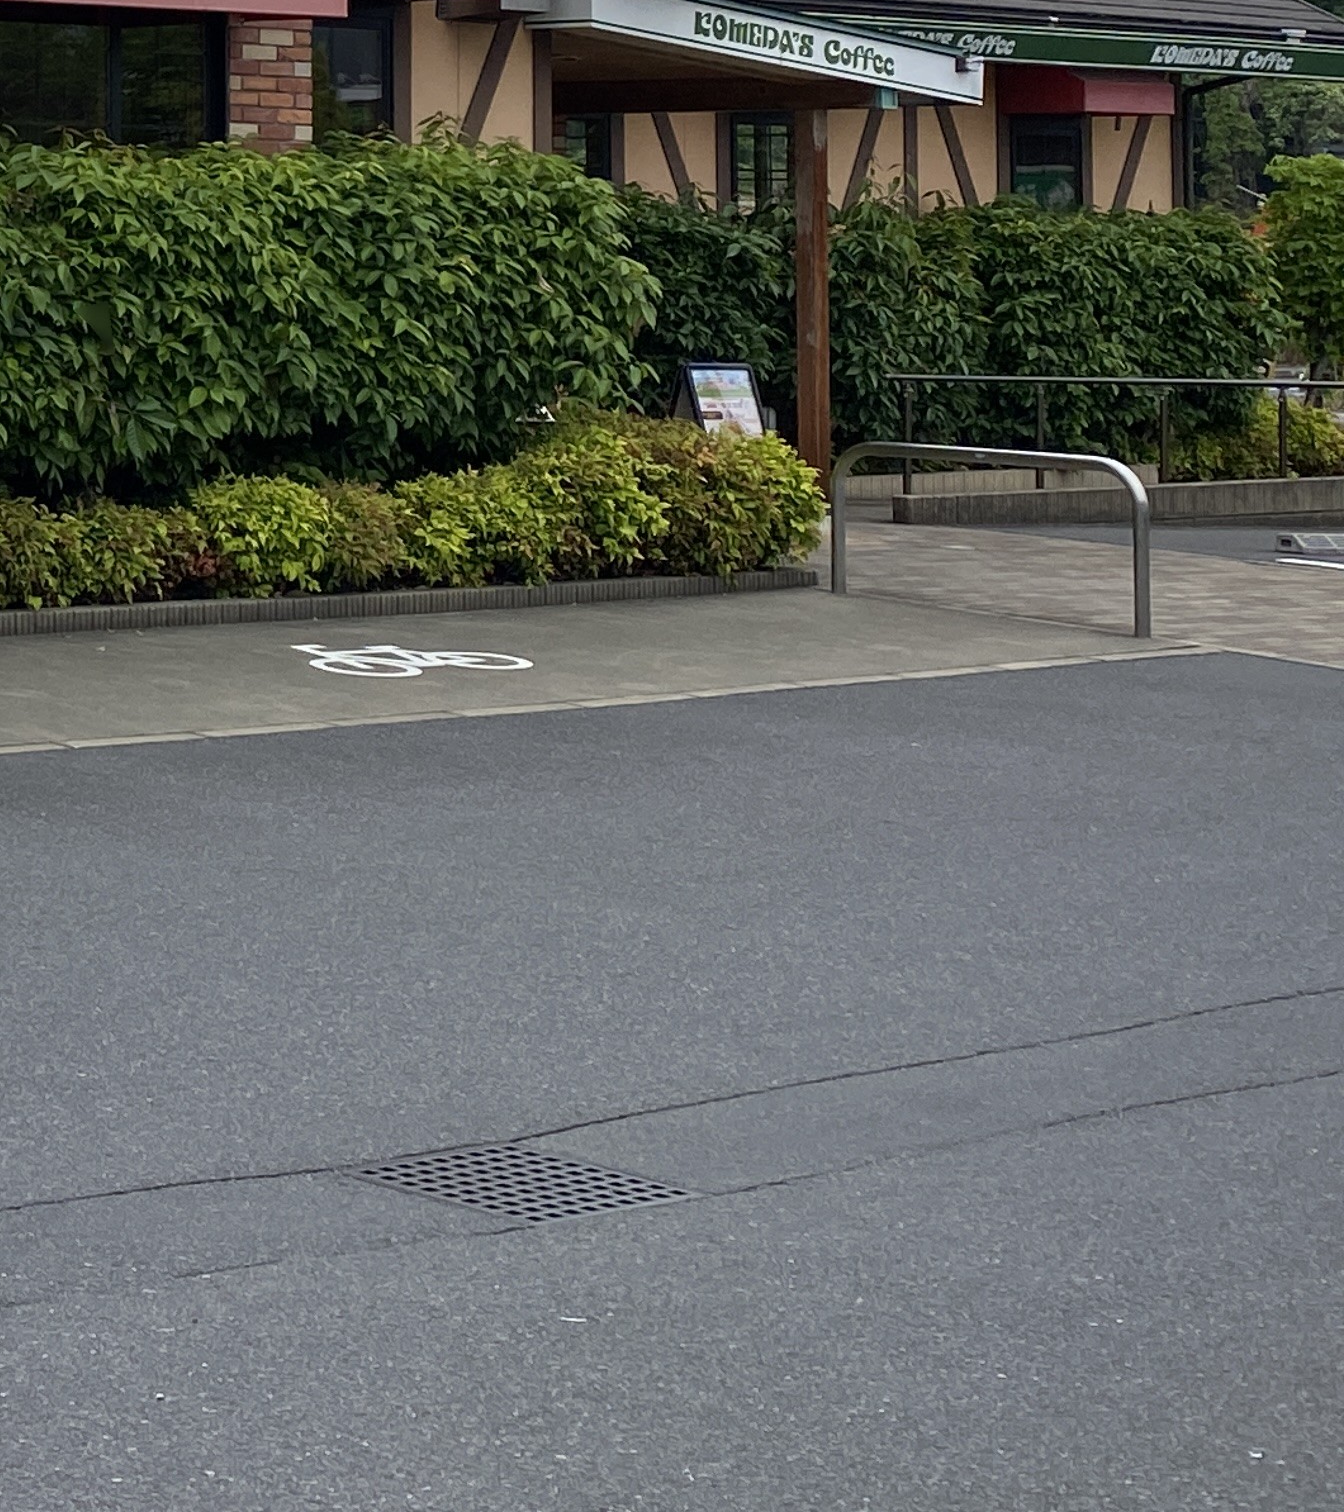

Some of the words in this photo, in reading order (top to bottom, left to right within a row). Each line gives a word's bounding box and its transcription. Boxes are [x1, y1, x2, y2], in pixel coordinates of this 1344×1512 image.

[694, 10, 814, 59] KOMEDA'S
[823, 40, 895, 76] Coffee
[1149, 44, 1241, 69] KOMEDA'S
[1240, 50, 1295, 72] Coffee
